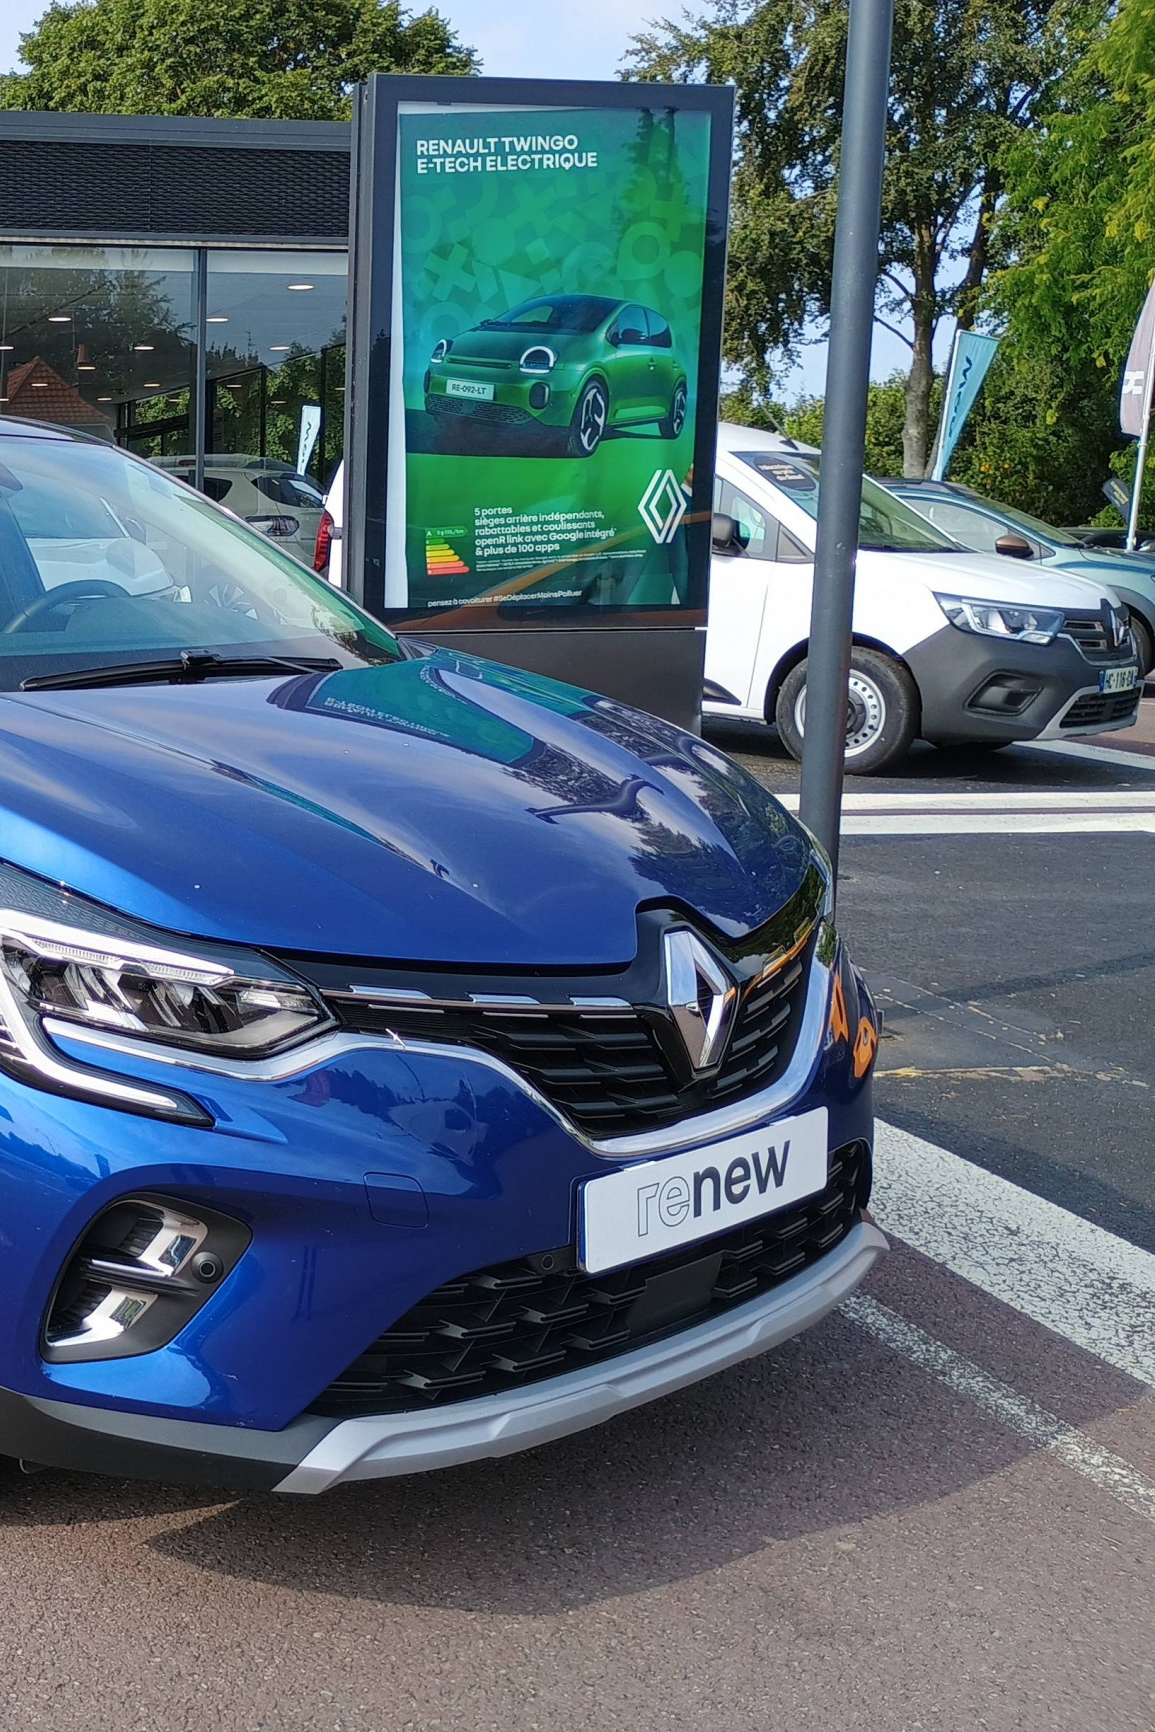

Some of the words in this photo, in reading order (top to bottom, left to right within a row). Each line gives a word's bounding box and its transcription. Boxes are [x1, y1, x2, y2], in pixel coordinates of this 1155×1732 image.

[416, 138, 499, 156] RENAULT
[500, 134, 578, 153] TWINGO
[417, 156, 482, 174] E-TECH
[485, 152, 598, 171] ELECTRIQUE
[451, 383, 487, 395] RE-092-LT
[474, 507, 481, 516] 5
[481, 506, 513, 518] portes
[474, 516, 505, 527] sièges
[506, 513, 538, 524] arrière
[538, 510, 605, 524] indépendants,
[474, 523, 531, 536] rabattables
[531, 523, 542, 532] et
[542, 520, 596, 531] coulissants
[475, 535, 506, 547] openR
[506, 534, 524, 544] link
[524, 533, 548, 543] avec
[548, 530, 584, 542] Google
[475, 547, 483, 556] &
[483, 545, 504, 557] plus
[504, 543, 518, 554] de
[518, 543, 534, 553] 100
[534, 543, 560, 553] apps
[427, 599, 452, 608] pensez
[452, 598, 458, 606] à
[636, 1139, 791, 1238] renew
